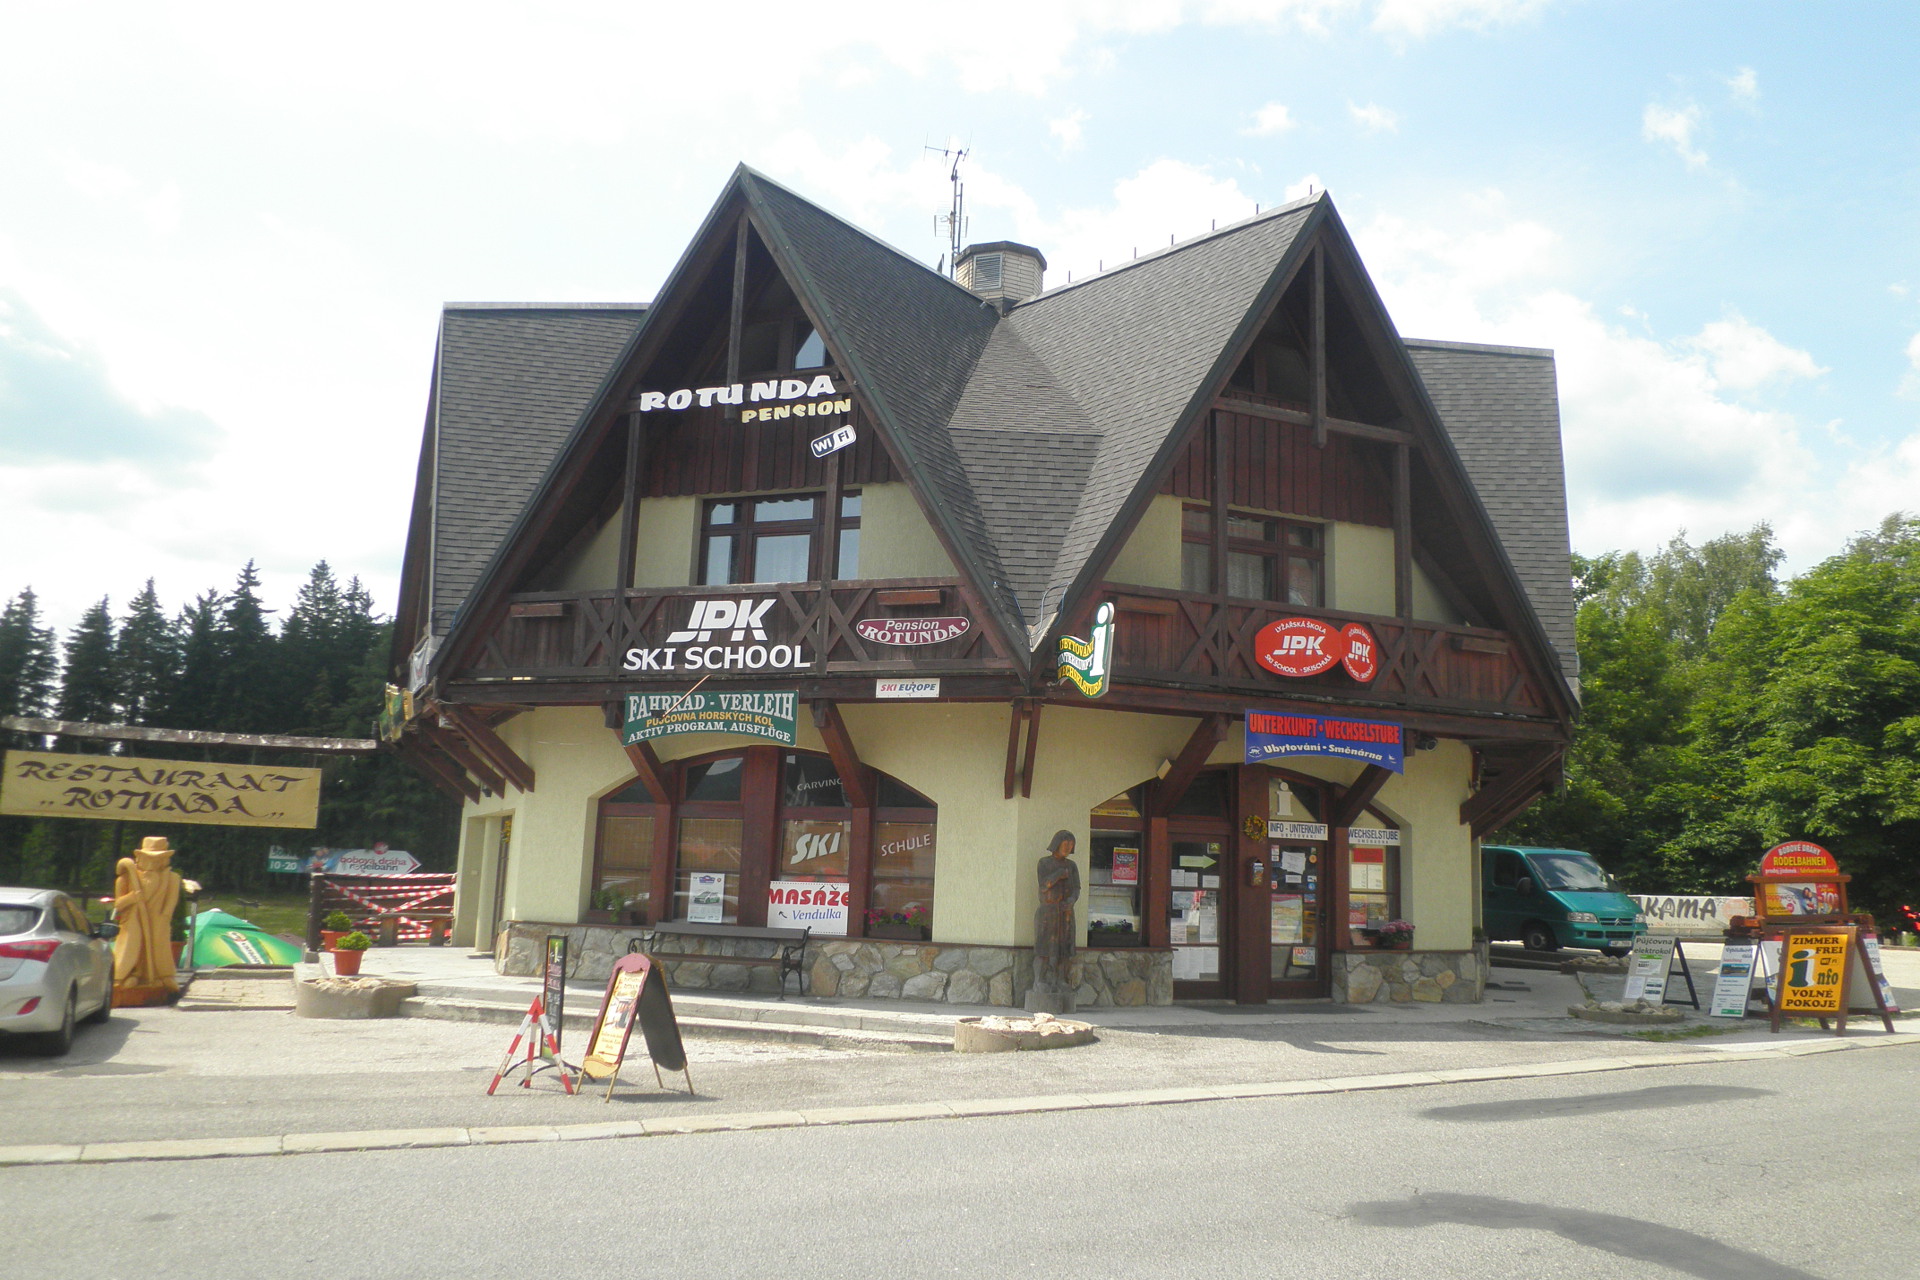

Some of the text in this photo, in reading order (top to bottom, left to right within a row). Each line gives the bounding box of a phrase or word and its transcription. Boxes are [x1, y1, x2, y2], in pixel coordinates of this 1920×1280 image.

[640, 375, 836, 412] ROTUNDA
[741, 399, 852, 424] PENSION
[666, 598, 777, 643] JPK
[885, 619, 939, 631] Pension
[1306, 620, 1327, 634] ŠKOLA
[863, 624, 961, 644] ROTUNDA
[1273, 635, 1325, 655] JPK
[1348, 640, 1371, 664] JPK
[623, 645, 811, 671] SKI SCHOOL
[1264, 654, 1275, 664] SKI
[1273, 661, 1297, 674] SCHOOL
[880, 682, 937, 692] SKI EUROPE
[628, 692, 794, 723] FAHRRAD VERLEIH
[700, 710, 751, 722] HORSKÝCH
[754, 715, 774, 727] KOL
[628, 722, 791, 743] AKTIV PROGRAM, AUSFLÜGE
[1249, 713, 1400, 744] UNTERKUNFT WECHSELSTUBE
[1263, 743, 1321, 754] Ubytování
[1328, 744, 1383, 761] Směnárna
[16, 760, 312, 793] RESTAURANT
[1269, 823, 1327, 835] INFO UNTERKUNFT
[1348, 829, 1399, 840] WECHSELSTUBE
[790, 832, 841, 864] SKI
[881, 834, 932, 857] SCHULE
[270, 860, 297, 870] 10-20
[1773, 857, 1827, 866] RODELBAHNEN
[792, 908, 842, 921] Vendulka
[1635, 937, 1673, 945] Půjčovna
[1634, 947, 1672, 955] elektrokol
[1785, 998, 1836, 1008] POKOJE
[1791, 989, 1834, 998] VOLNÉ
